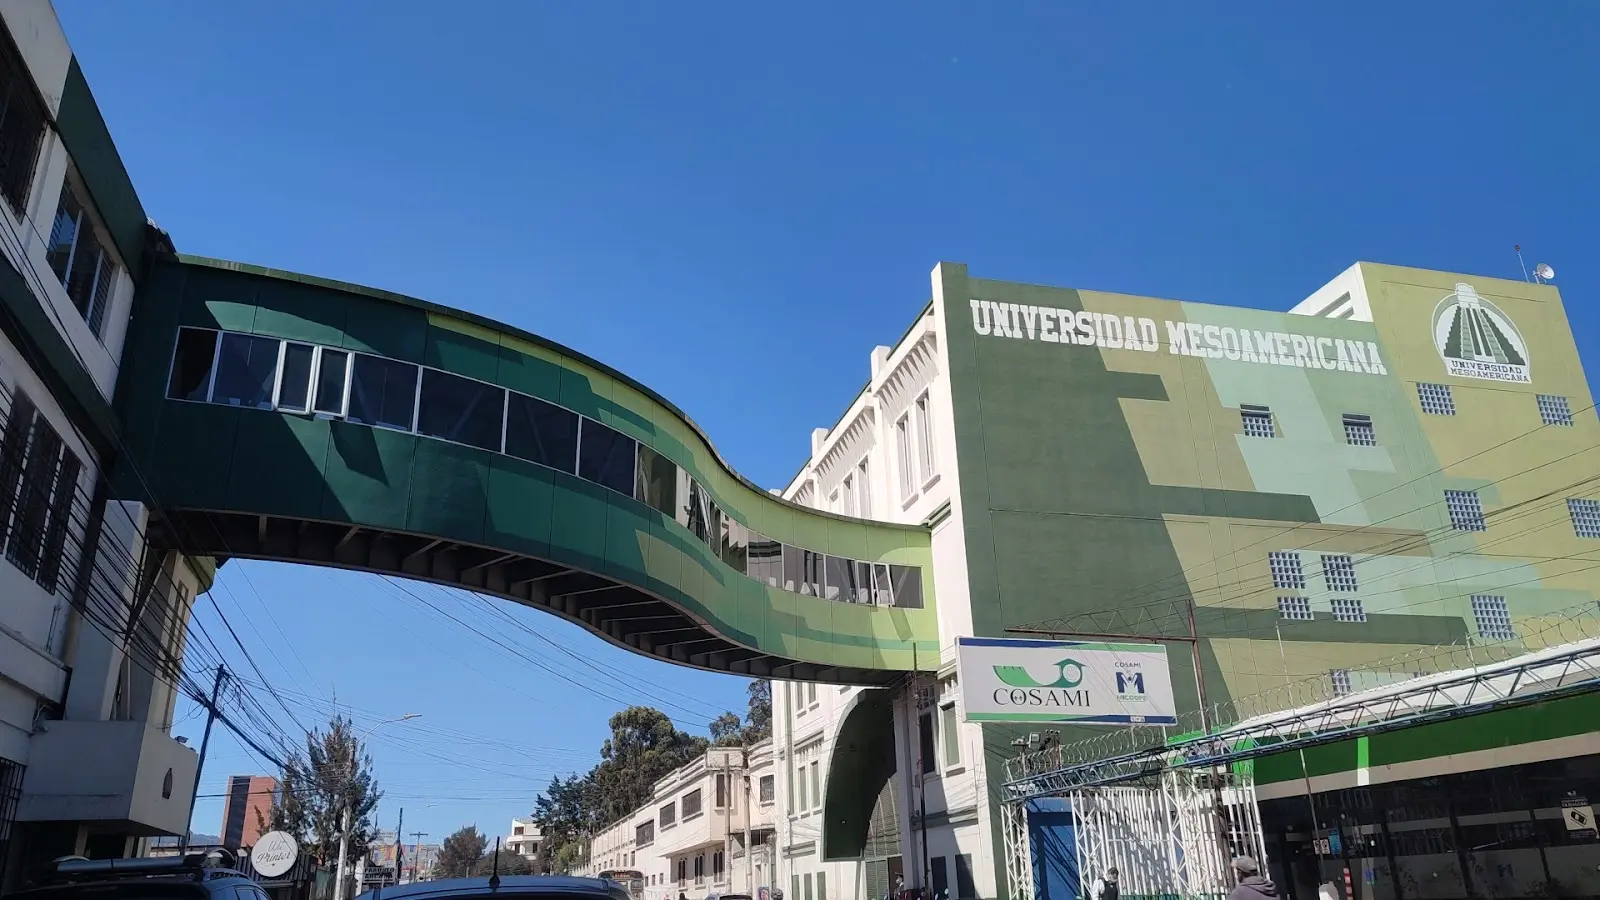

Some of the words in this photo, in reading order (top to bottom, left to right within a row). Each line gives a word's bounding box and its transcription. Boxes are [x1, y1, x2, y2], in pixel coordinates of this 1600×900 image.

[969, 299, 1159, 352] UNIVERSIDAD
[1165, 320, 1388, 376] MESOAMERICANA
[1450, 367, 1530, 382] MESOAMERICANA
[1451, 360, 1522, 374] UNIVERSIDAD
[1114, 661, 1142, 669] COSAMI
[993, 688, 1092, 707] COSAMI
